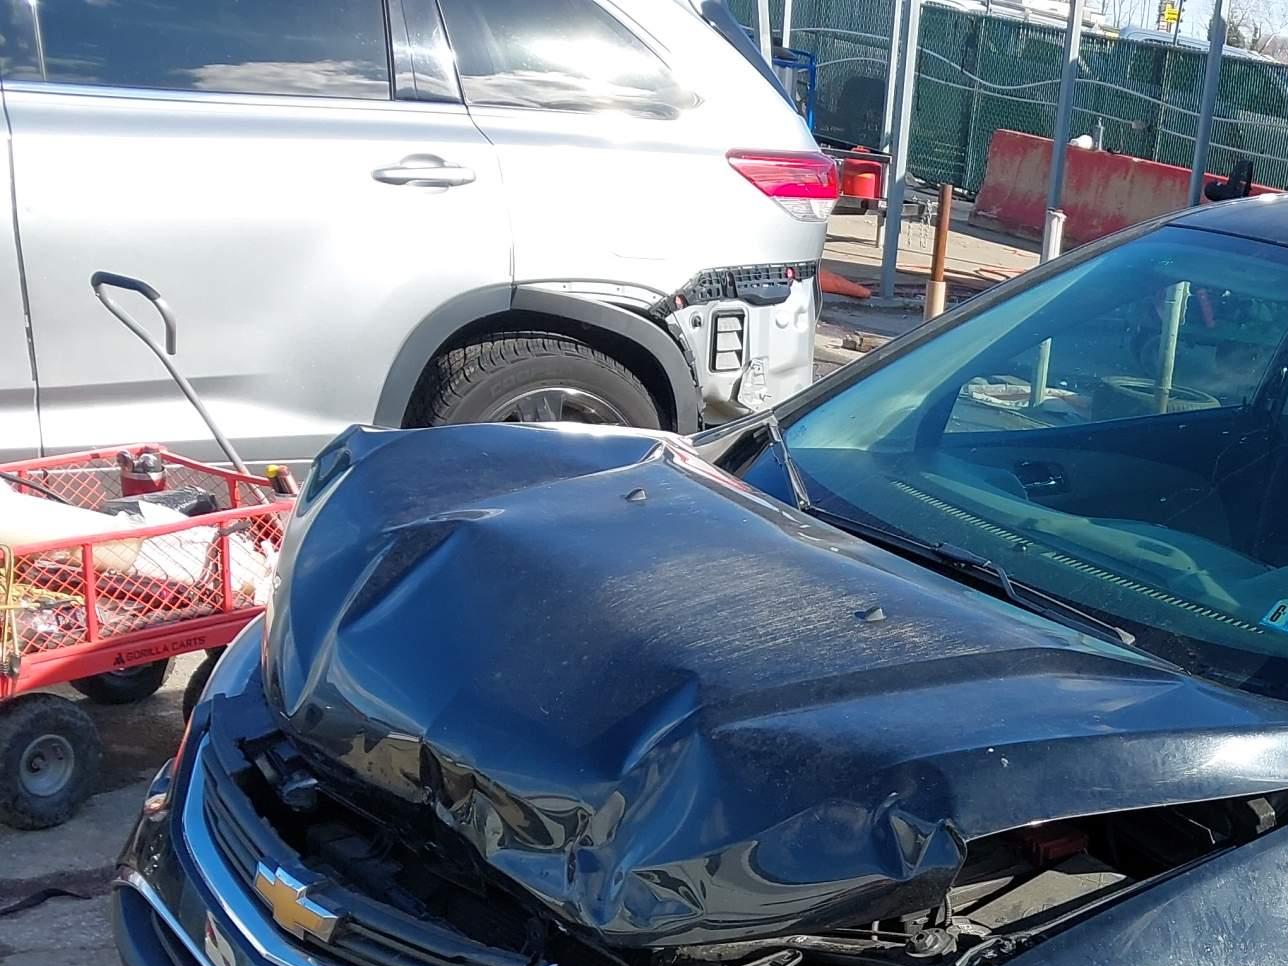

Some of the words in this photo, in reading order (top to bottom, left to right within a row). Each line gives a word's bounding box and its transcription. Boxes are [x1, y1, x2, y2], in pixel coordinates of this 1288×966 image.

[1270, 604, 1286, 622] 6
[127, 647, 169, 661] GORILLA
[171, 636, 206, 650] CARTS
